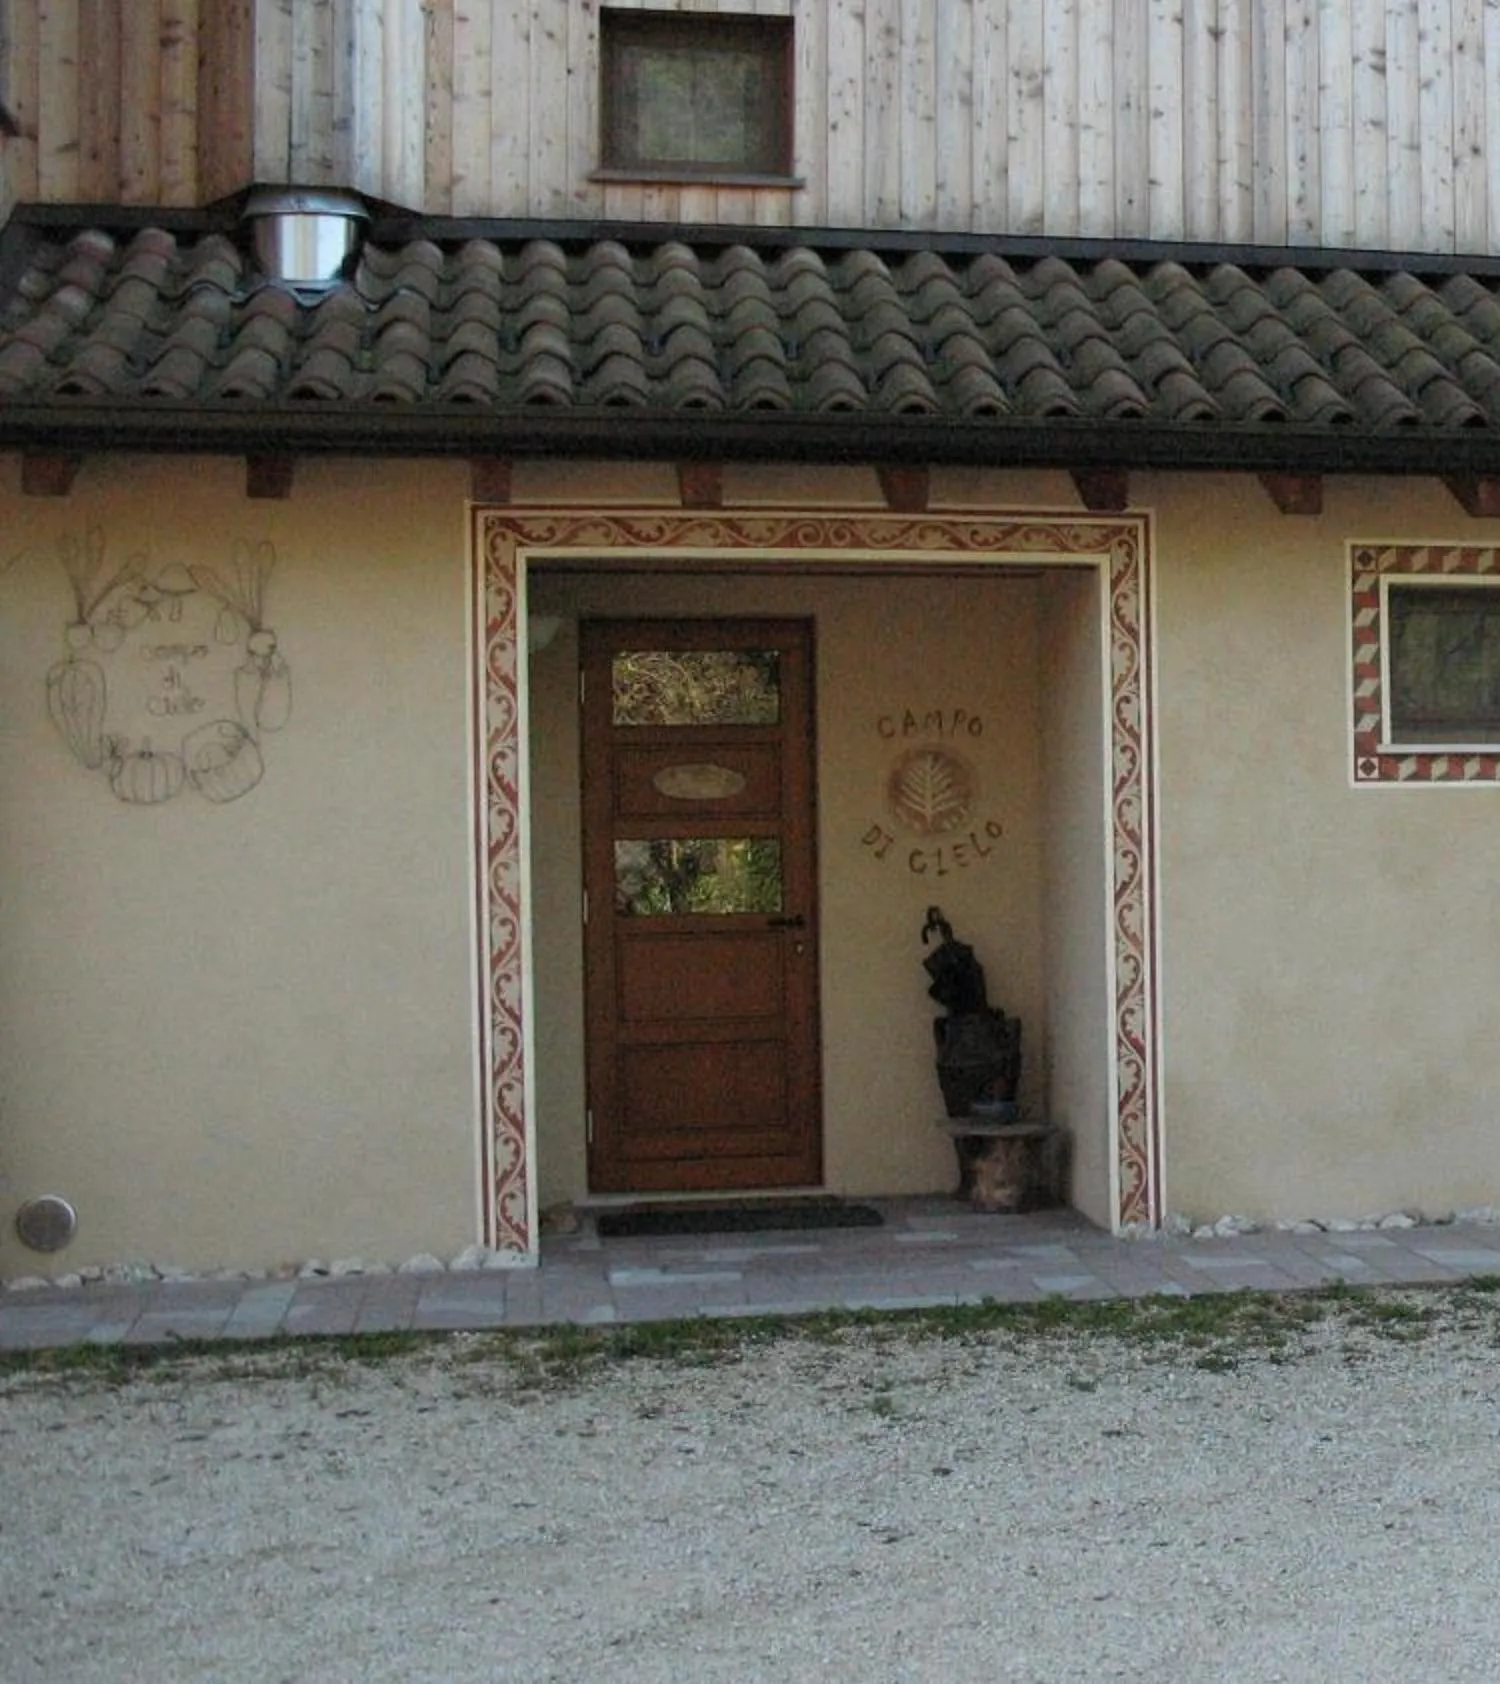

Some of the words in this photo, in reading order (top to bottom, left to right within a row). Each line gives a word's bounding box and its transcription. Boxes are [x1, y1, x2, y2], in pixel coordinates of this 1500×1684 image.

[877, 709, 983, 738] CAMPO
[861, 824, 894, 859] DI
[908, 820, 1003, 876] CIELO
